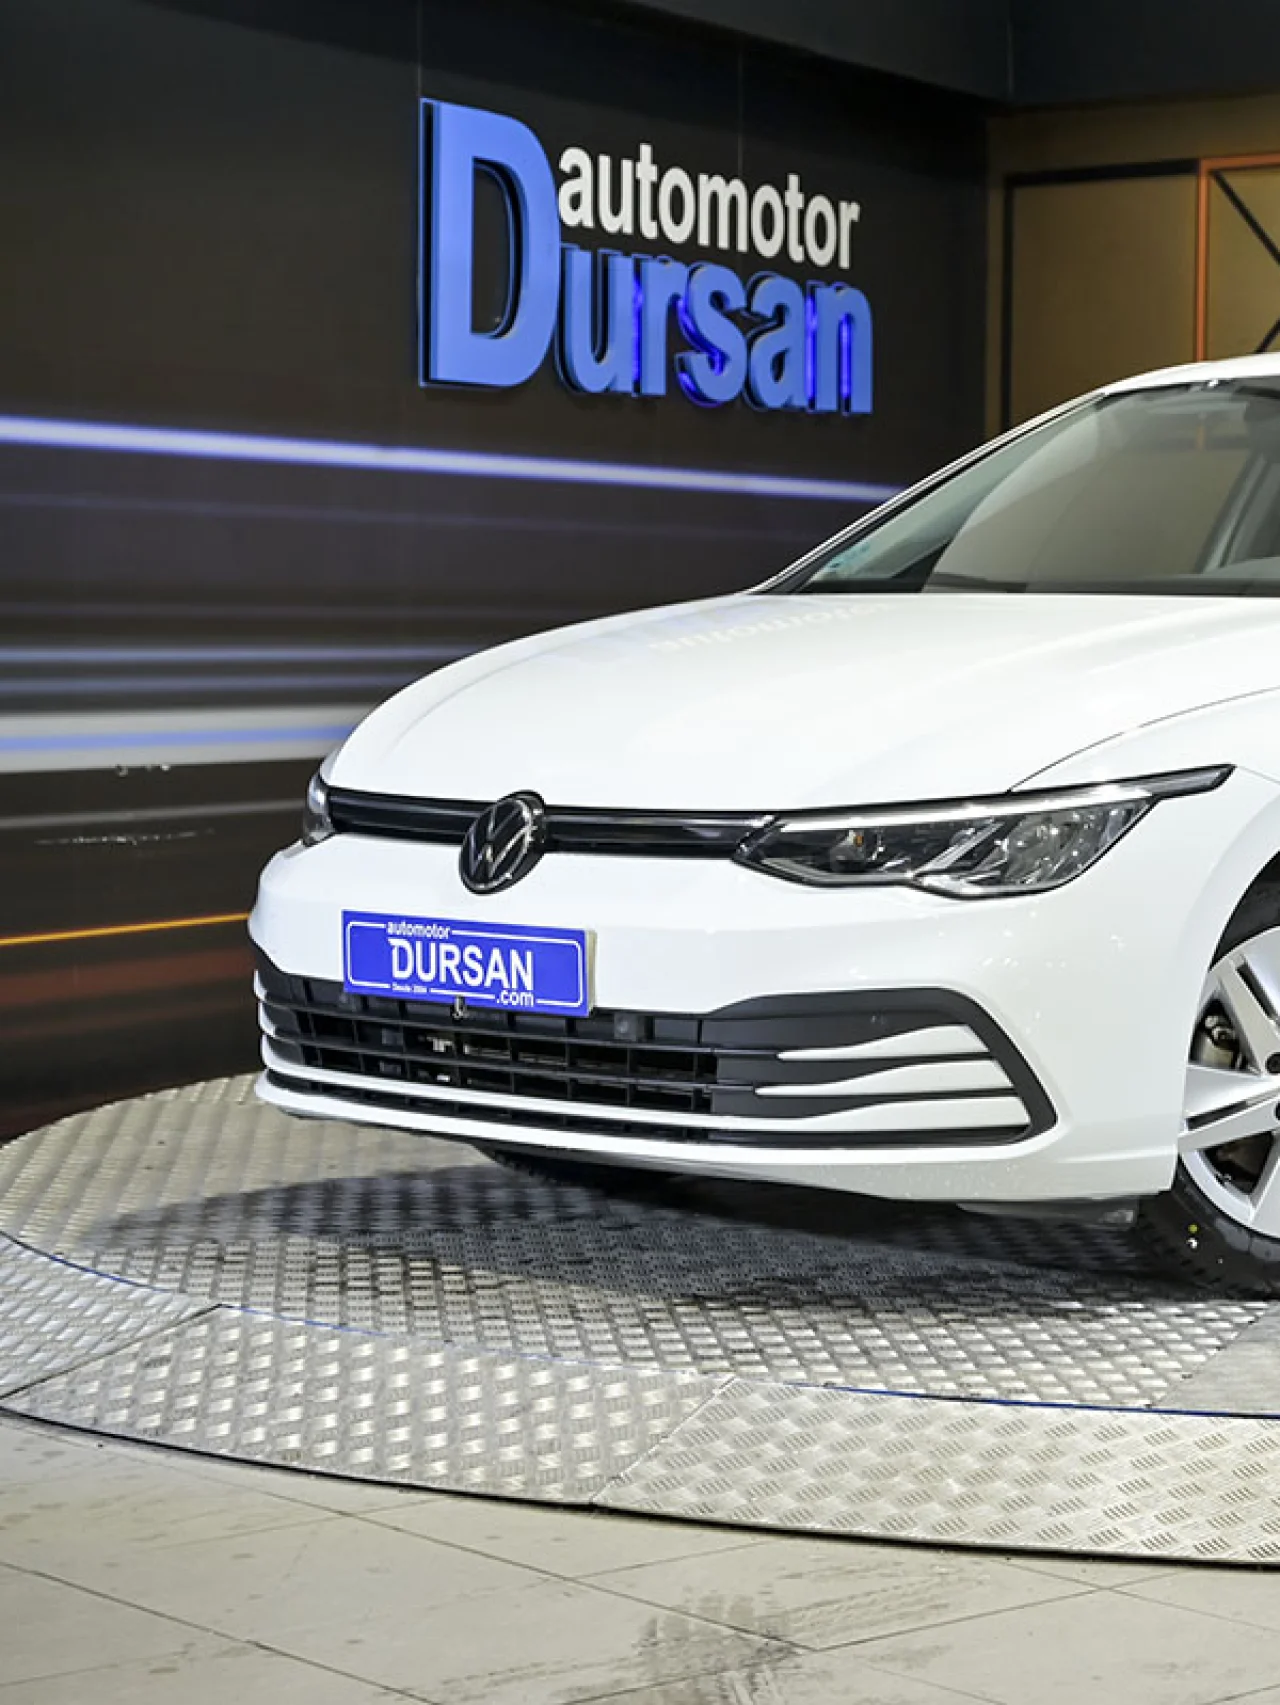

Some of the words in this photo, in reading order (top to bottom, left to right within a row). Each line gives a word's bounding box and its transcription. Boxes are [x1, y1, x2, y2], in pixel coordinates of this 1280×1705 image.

[559, 143, 860, 269] automotor
[419, 97, 874, 415] Dursan
[387, 921, 451, 939] automotor
[388, 938, 534, 990] DURSAN
[496, 989, 535, 1007] .com
